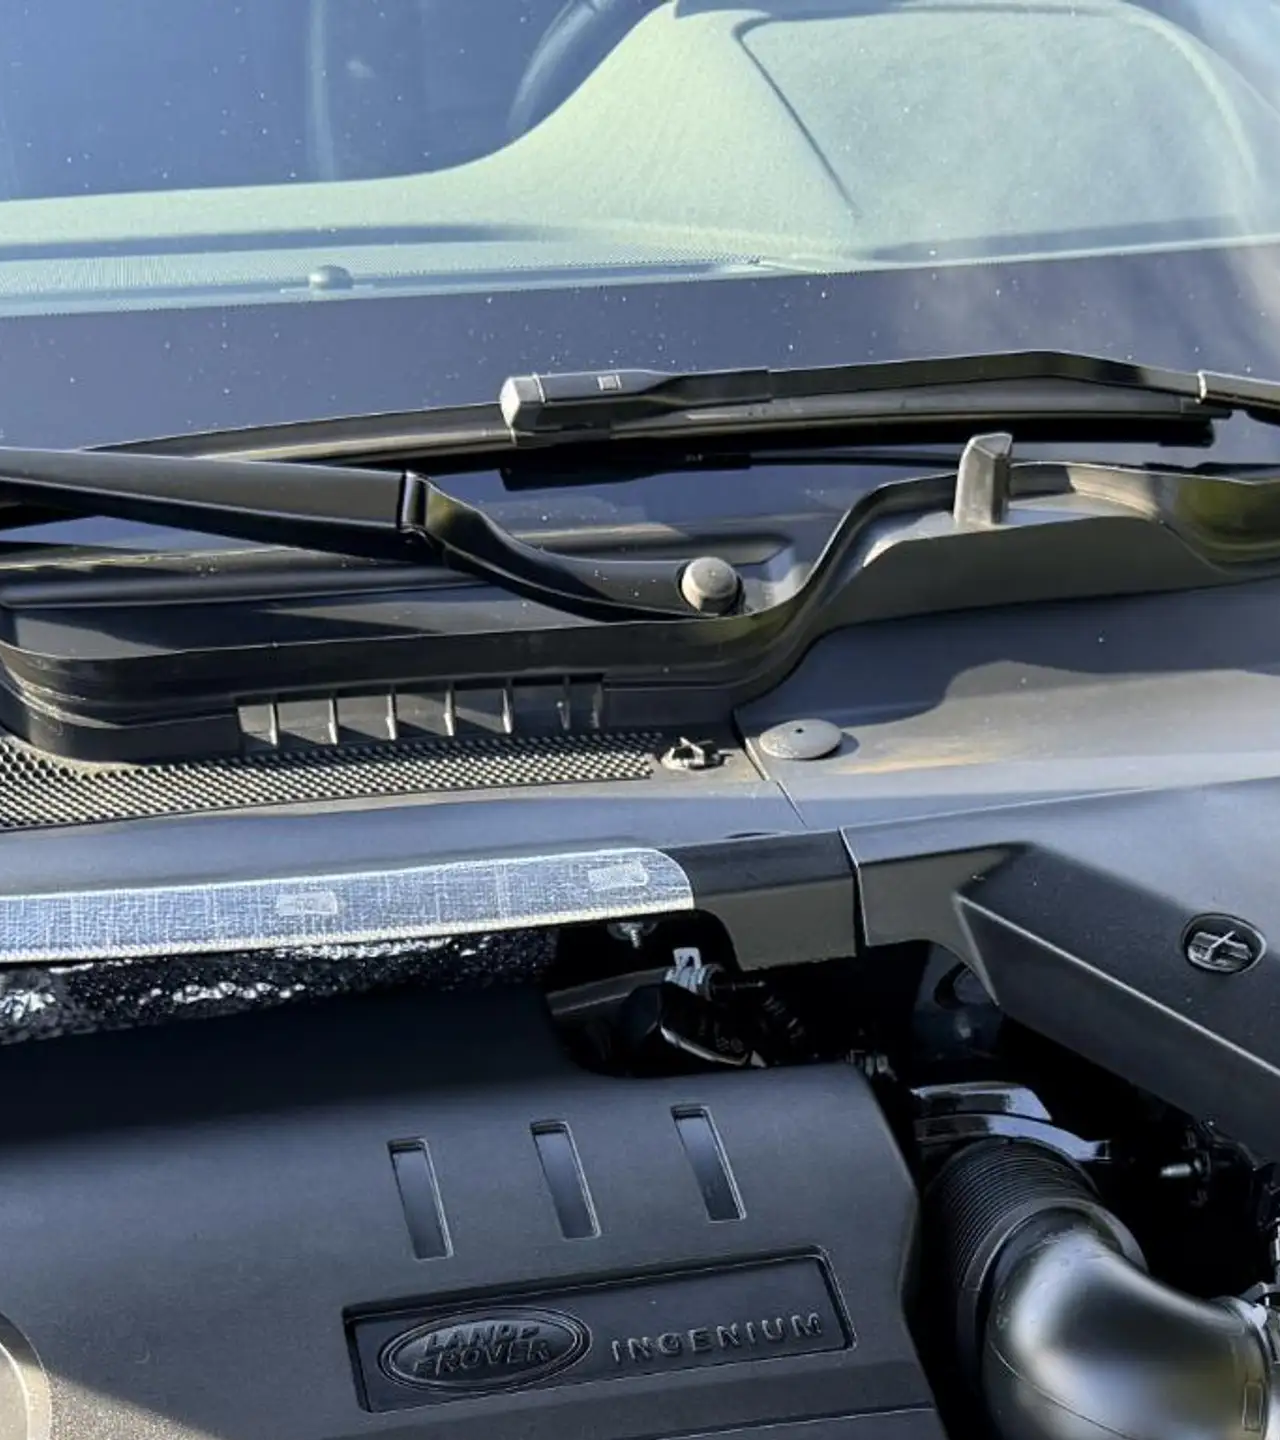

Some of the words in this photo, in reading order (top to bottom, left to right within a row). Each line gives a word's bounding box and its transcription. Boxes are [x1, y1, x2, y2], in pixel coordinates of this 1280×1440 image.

[424, 1323, 521, 1355] LAND
[434, 1336, 553, 1378] ROVER
[610, 1311, 823, 1364] INGENIUM
